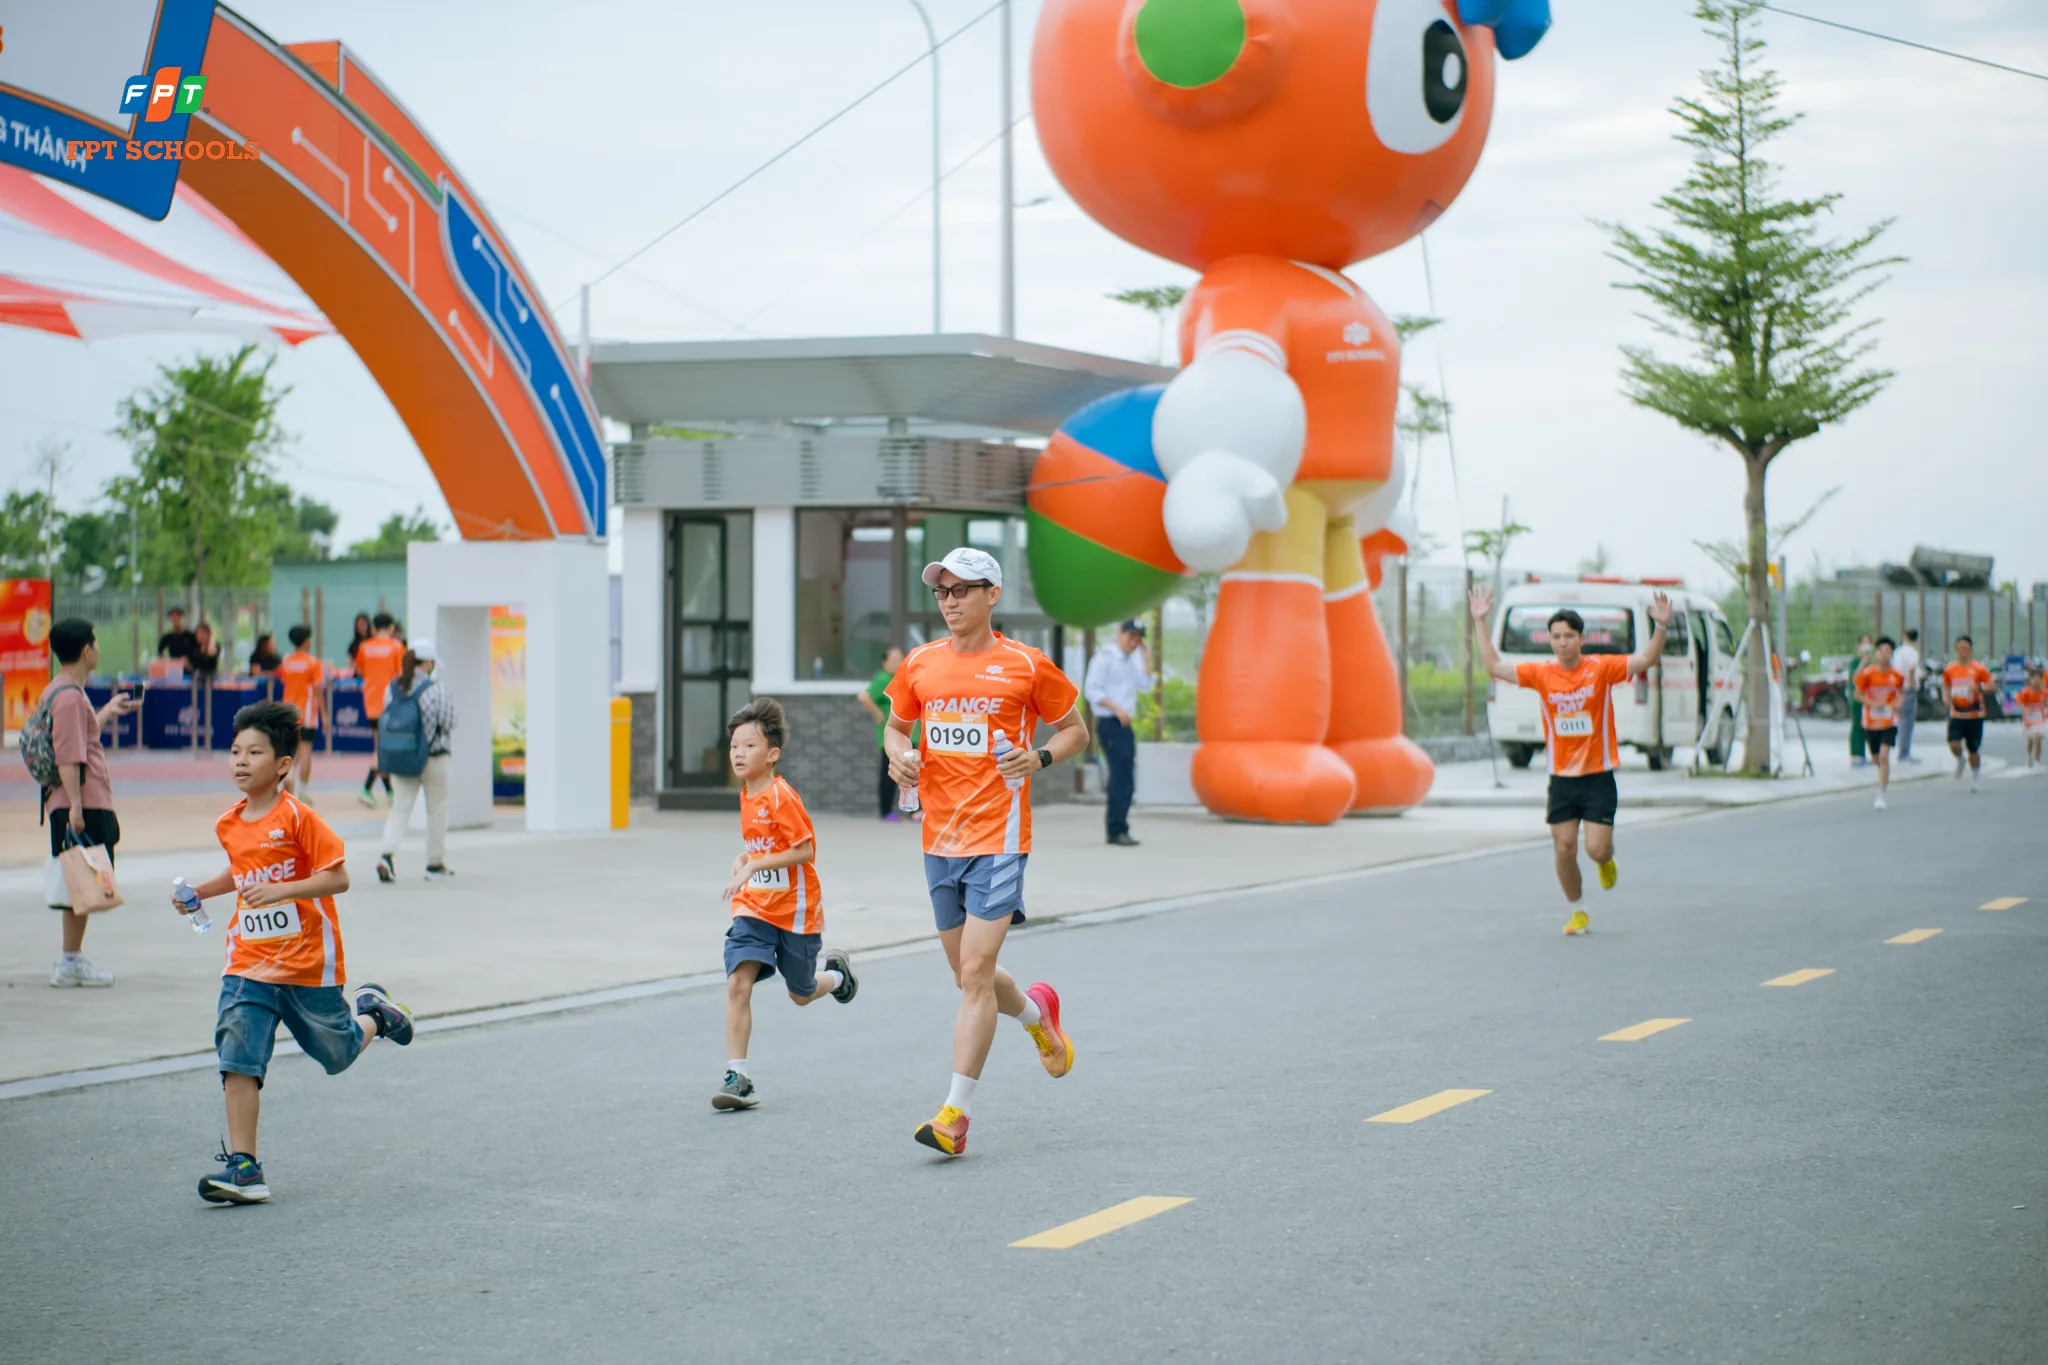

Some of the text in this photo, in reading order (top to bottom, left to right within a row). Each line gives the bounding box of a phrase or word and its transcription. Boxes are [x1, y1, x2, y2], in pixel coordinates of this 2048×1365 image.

[925, 696, 1004, 715] ORANGE
[1560, 720, 1585, 732] 0111
[930, 726, 981, 747] 0190
[244, 911, 289, 933] 0110
